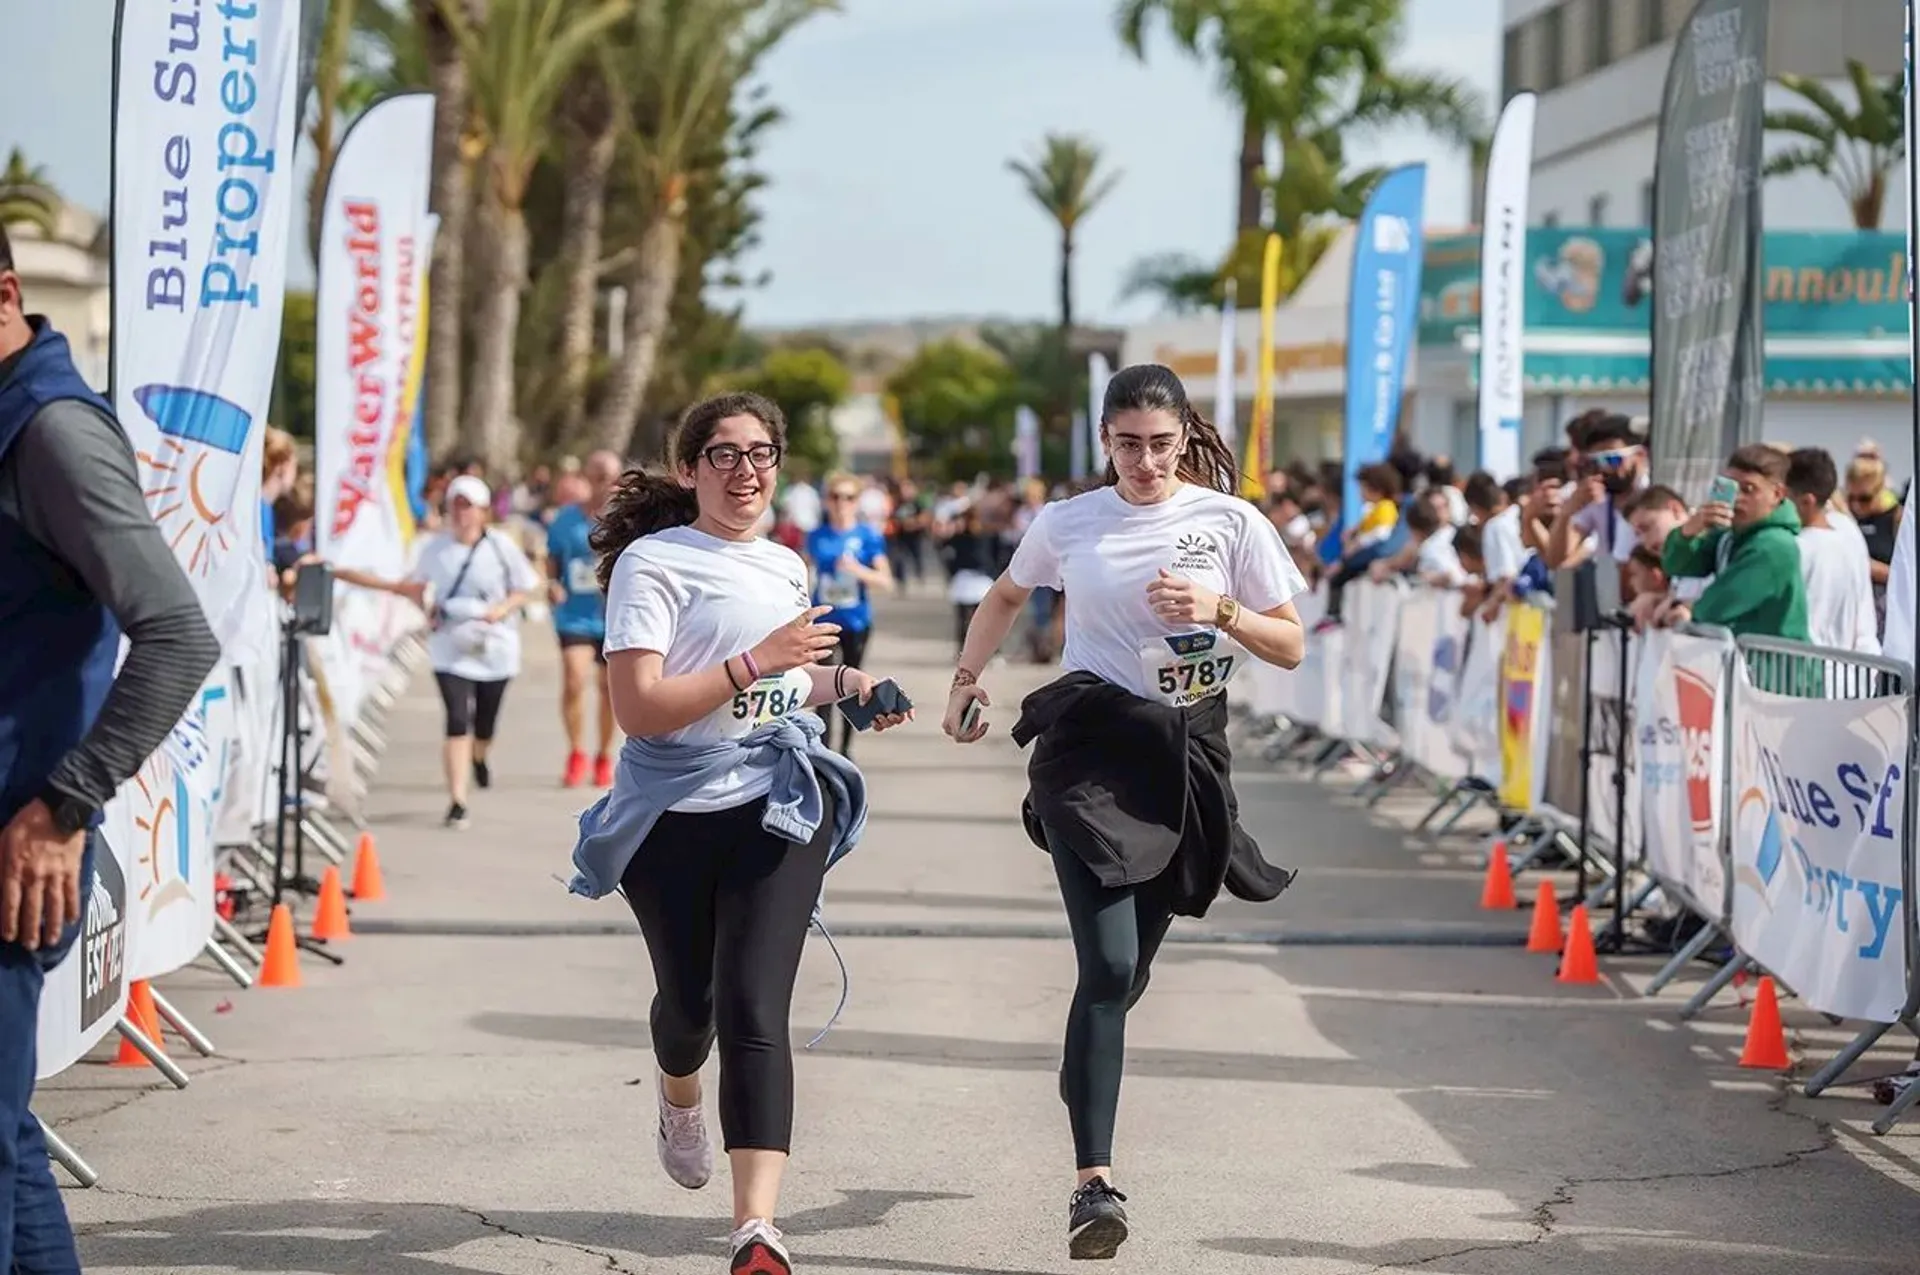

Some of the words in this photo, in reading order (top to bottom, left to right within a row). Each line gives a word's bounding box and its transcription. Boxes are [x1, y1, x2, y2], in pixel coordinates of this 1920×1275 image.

[154, 0, 200, 105] Su
[202, 0, 274, 308] Propert
[147, 135, 190, 312] Blue
[1765, 252, 1911, 303] nnoul
[733, 687, 798, 719] 5786
[1158, 655, 1234, 694] 5787
